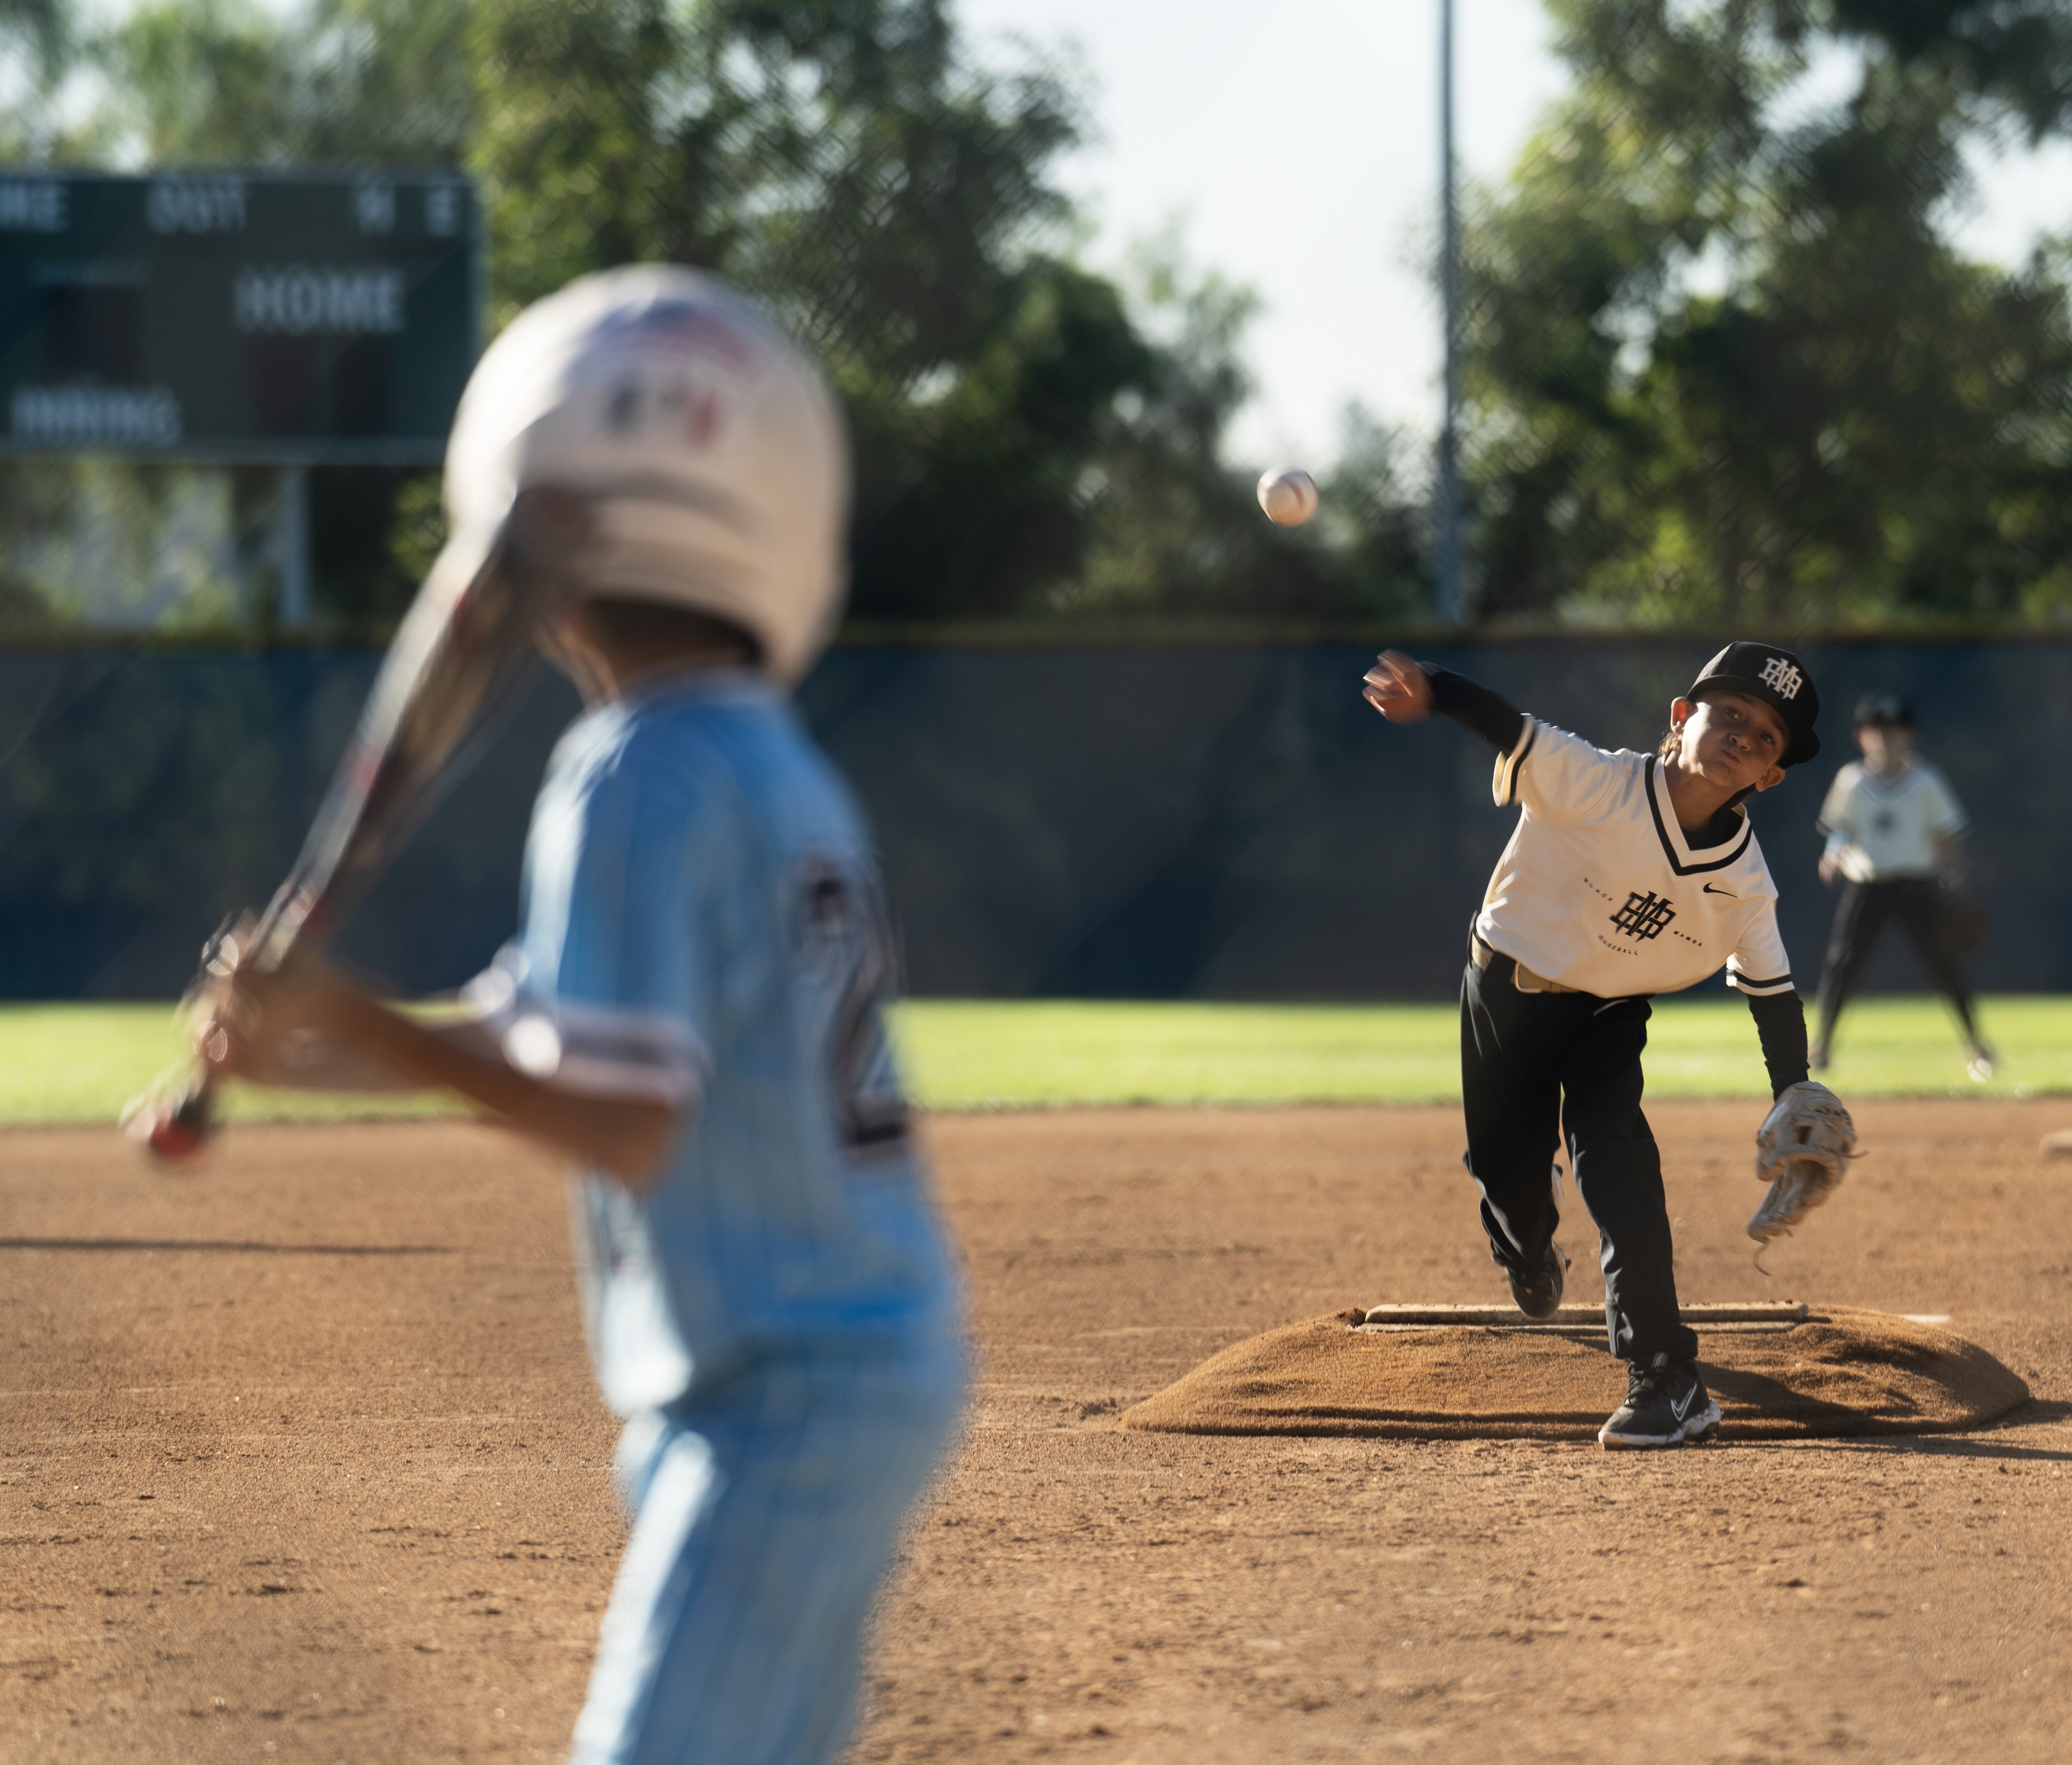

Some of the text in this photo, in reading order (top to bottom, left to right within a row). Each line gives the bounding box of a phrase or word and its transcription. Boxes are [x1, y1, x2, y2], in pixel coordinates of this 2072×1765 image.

[235, 267, 405, 334] HOME
[1583, 877, 1703, 947] BLACK MAMBA
[1597, 934, 1638, 955] BASEBALL
